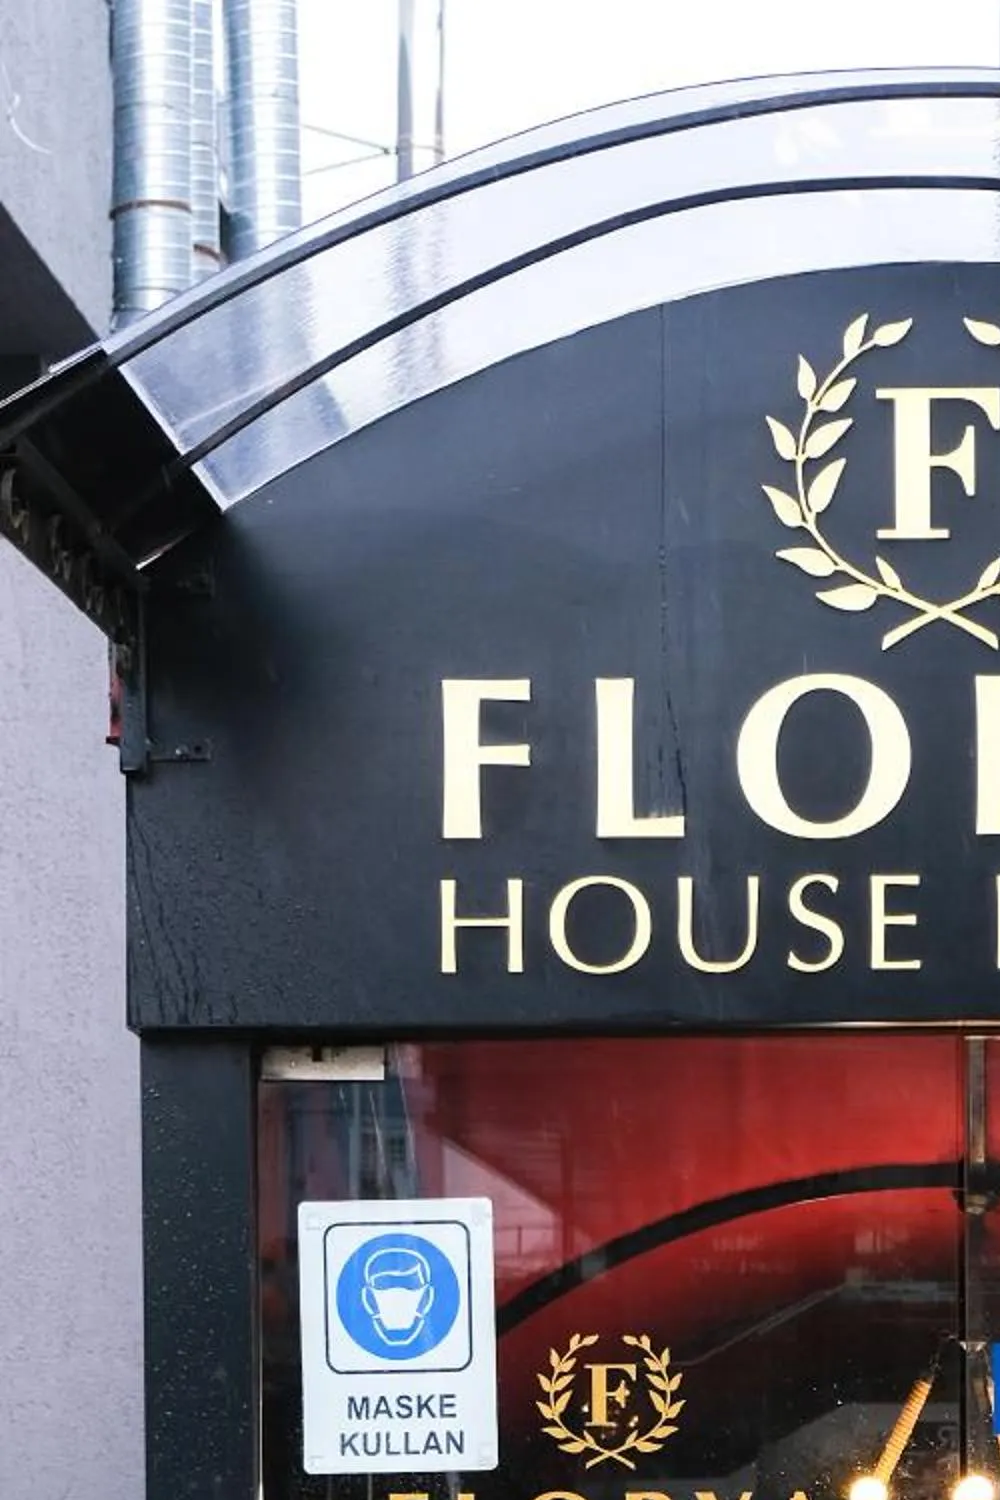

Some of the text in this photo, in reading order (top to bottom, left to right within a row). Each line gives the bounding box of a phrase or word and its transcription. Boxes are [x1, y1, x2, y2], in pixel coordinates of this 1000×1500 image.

[440, 873, 921, 974] HOUSE
[347, 1393, 458, 1420] MASKE
[584, 1363, 638, 1427] F
[340, 1430, 465, 1457] KULLAN
